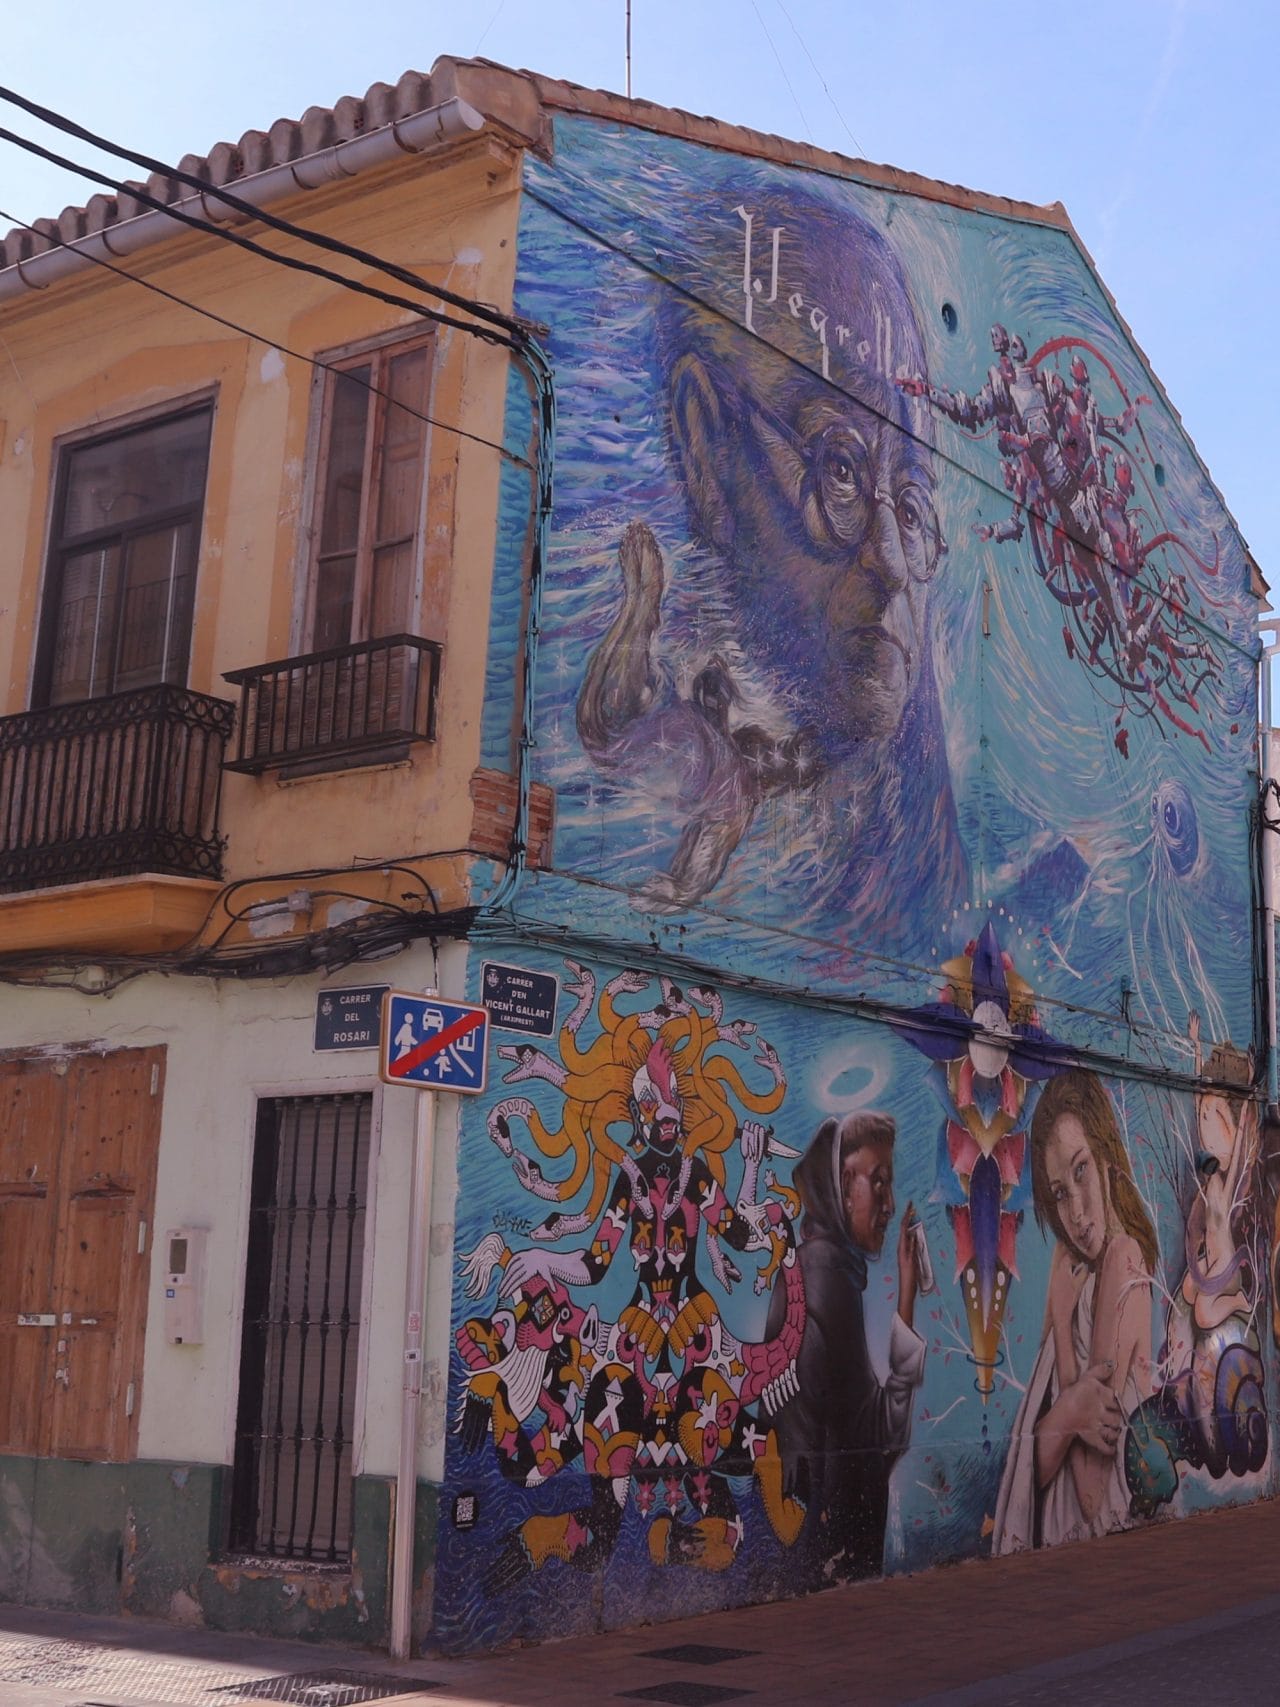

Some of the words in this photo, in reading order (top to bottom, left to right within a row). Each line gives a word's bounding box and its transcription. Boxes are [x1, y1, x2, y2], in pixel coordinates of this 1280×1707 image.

[506, 976, 534, 988] CARRER
[339, 994, 371, 1005] CARRER
[485, 998, 514, 1012] VICENT
[515, 1004, 551, 1020] GALLART
[344, 1012, 360, 1022] DEL
[333, 1030, 371, 1043] ROSARI
